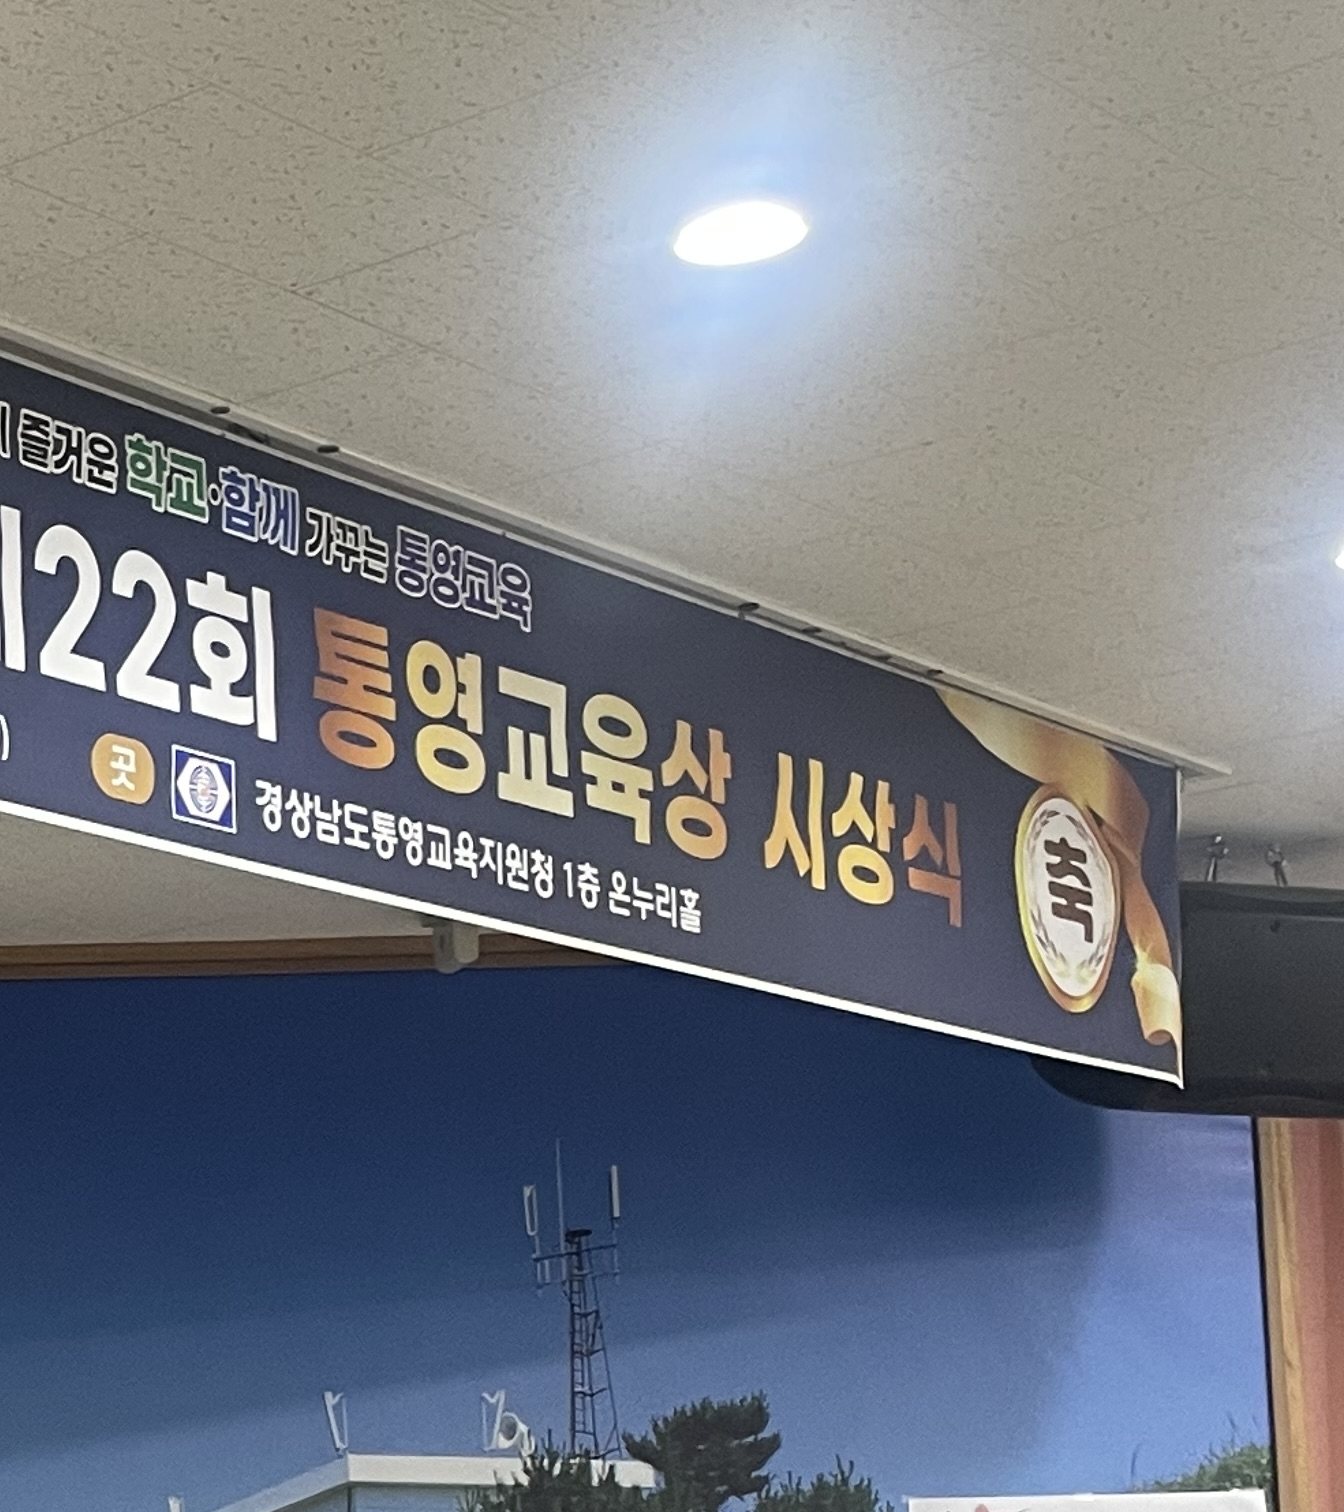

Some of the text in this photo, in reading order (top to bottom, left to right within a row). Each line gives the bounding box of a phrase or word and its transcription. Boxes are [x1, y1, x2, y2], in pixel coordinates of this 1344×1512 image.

[18, 409, 118, 493] 즐거운
[304, 507, 388, 583] 가꾸는
[394, 525, 533, 631] 통영교육
[109, 742, 138, 789] 곳
[313, 606, 732, 861] 통영교육상
[764, 752, 963, 928] 시상식
[254, 778, 702, 935] 경상남도통영교육지원청 1층 온누리홀
[1044, 837, 1094, 945] 축
